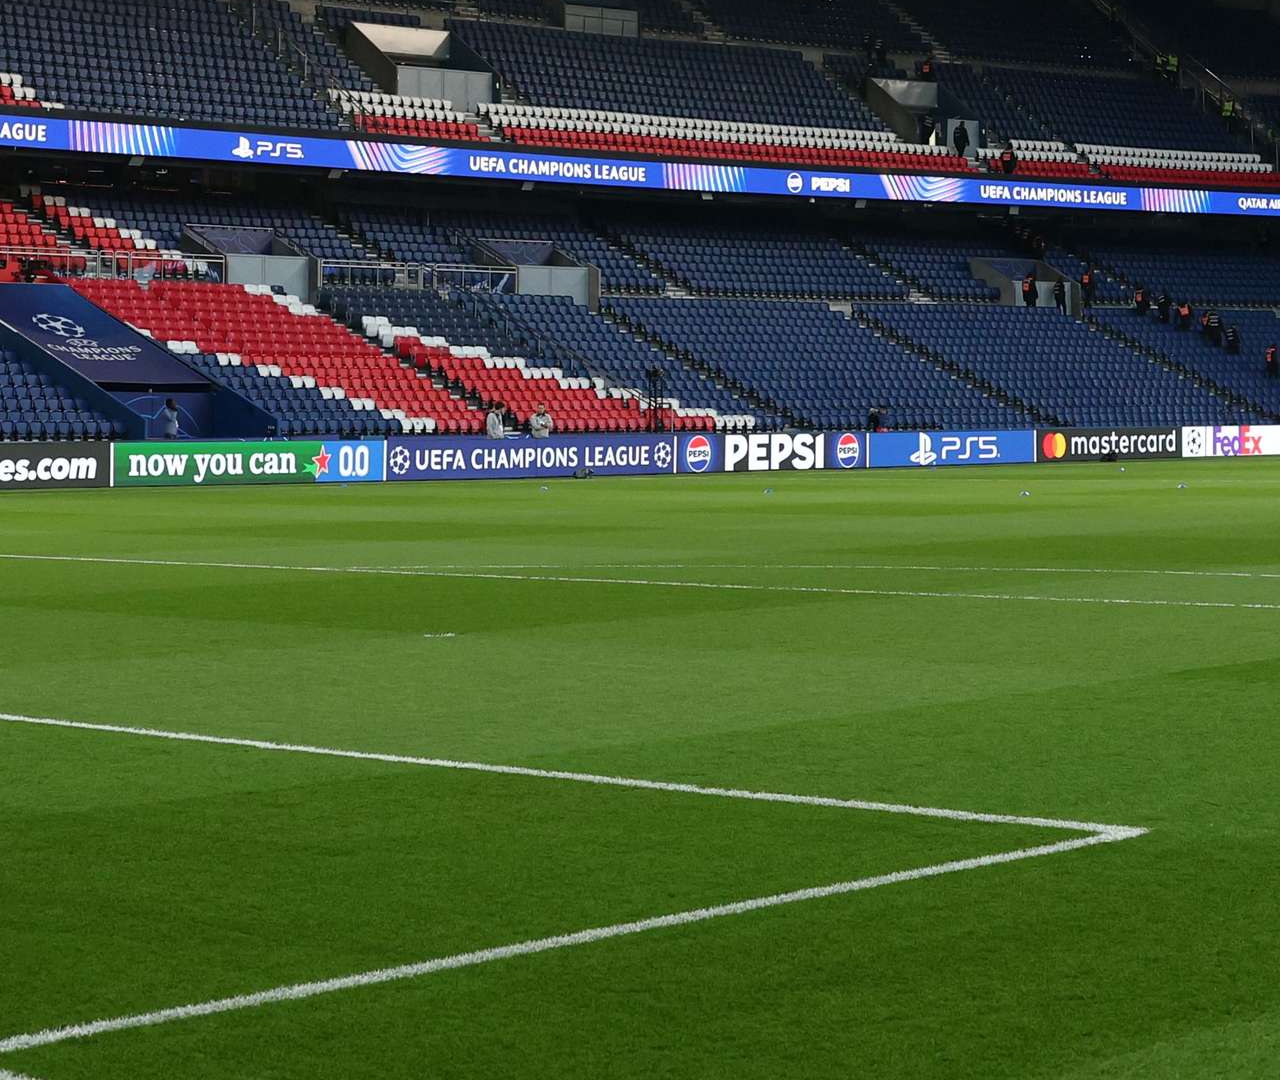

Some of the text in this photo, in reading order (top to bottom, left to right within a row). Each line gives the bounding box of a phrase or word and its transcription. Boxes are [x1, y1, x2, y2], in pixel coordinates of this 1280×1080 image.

[469, 155, 646, 182] UEFA CHAMPIONS LEAGUE
[811, 176, 850, 193] PEPSI
[980, 185, 1127, 206] UEFA CHAMPIONS LEAGUE
[1238, 197, 1267, 211] QATAR
[46, 343, 142, 354] CHAMPIONS
[724, 433, 825, 472] PEPSI
[839, 447, 858, 455] PEPSI
[941, 436, 998, 460] PS5
[1071, 429, 1176, 455] mastercard
[1212, 424, 1263, 456] FedEx
[339, 445, 369, 477] 0.0
[415, 445, 650, 471] UEFA CHAMPIONS LEAGUE
[688, 450, 709, 458] PEPSI
[128, 452, 297, 483] now you can
